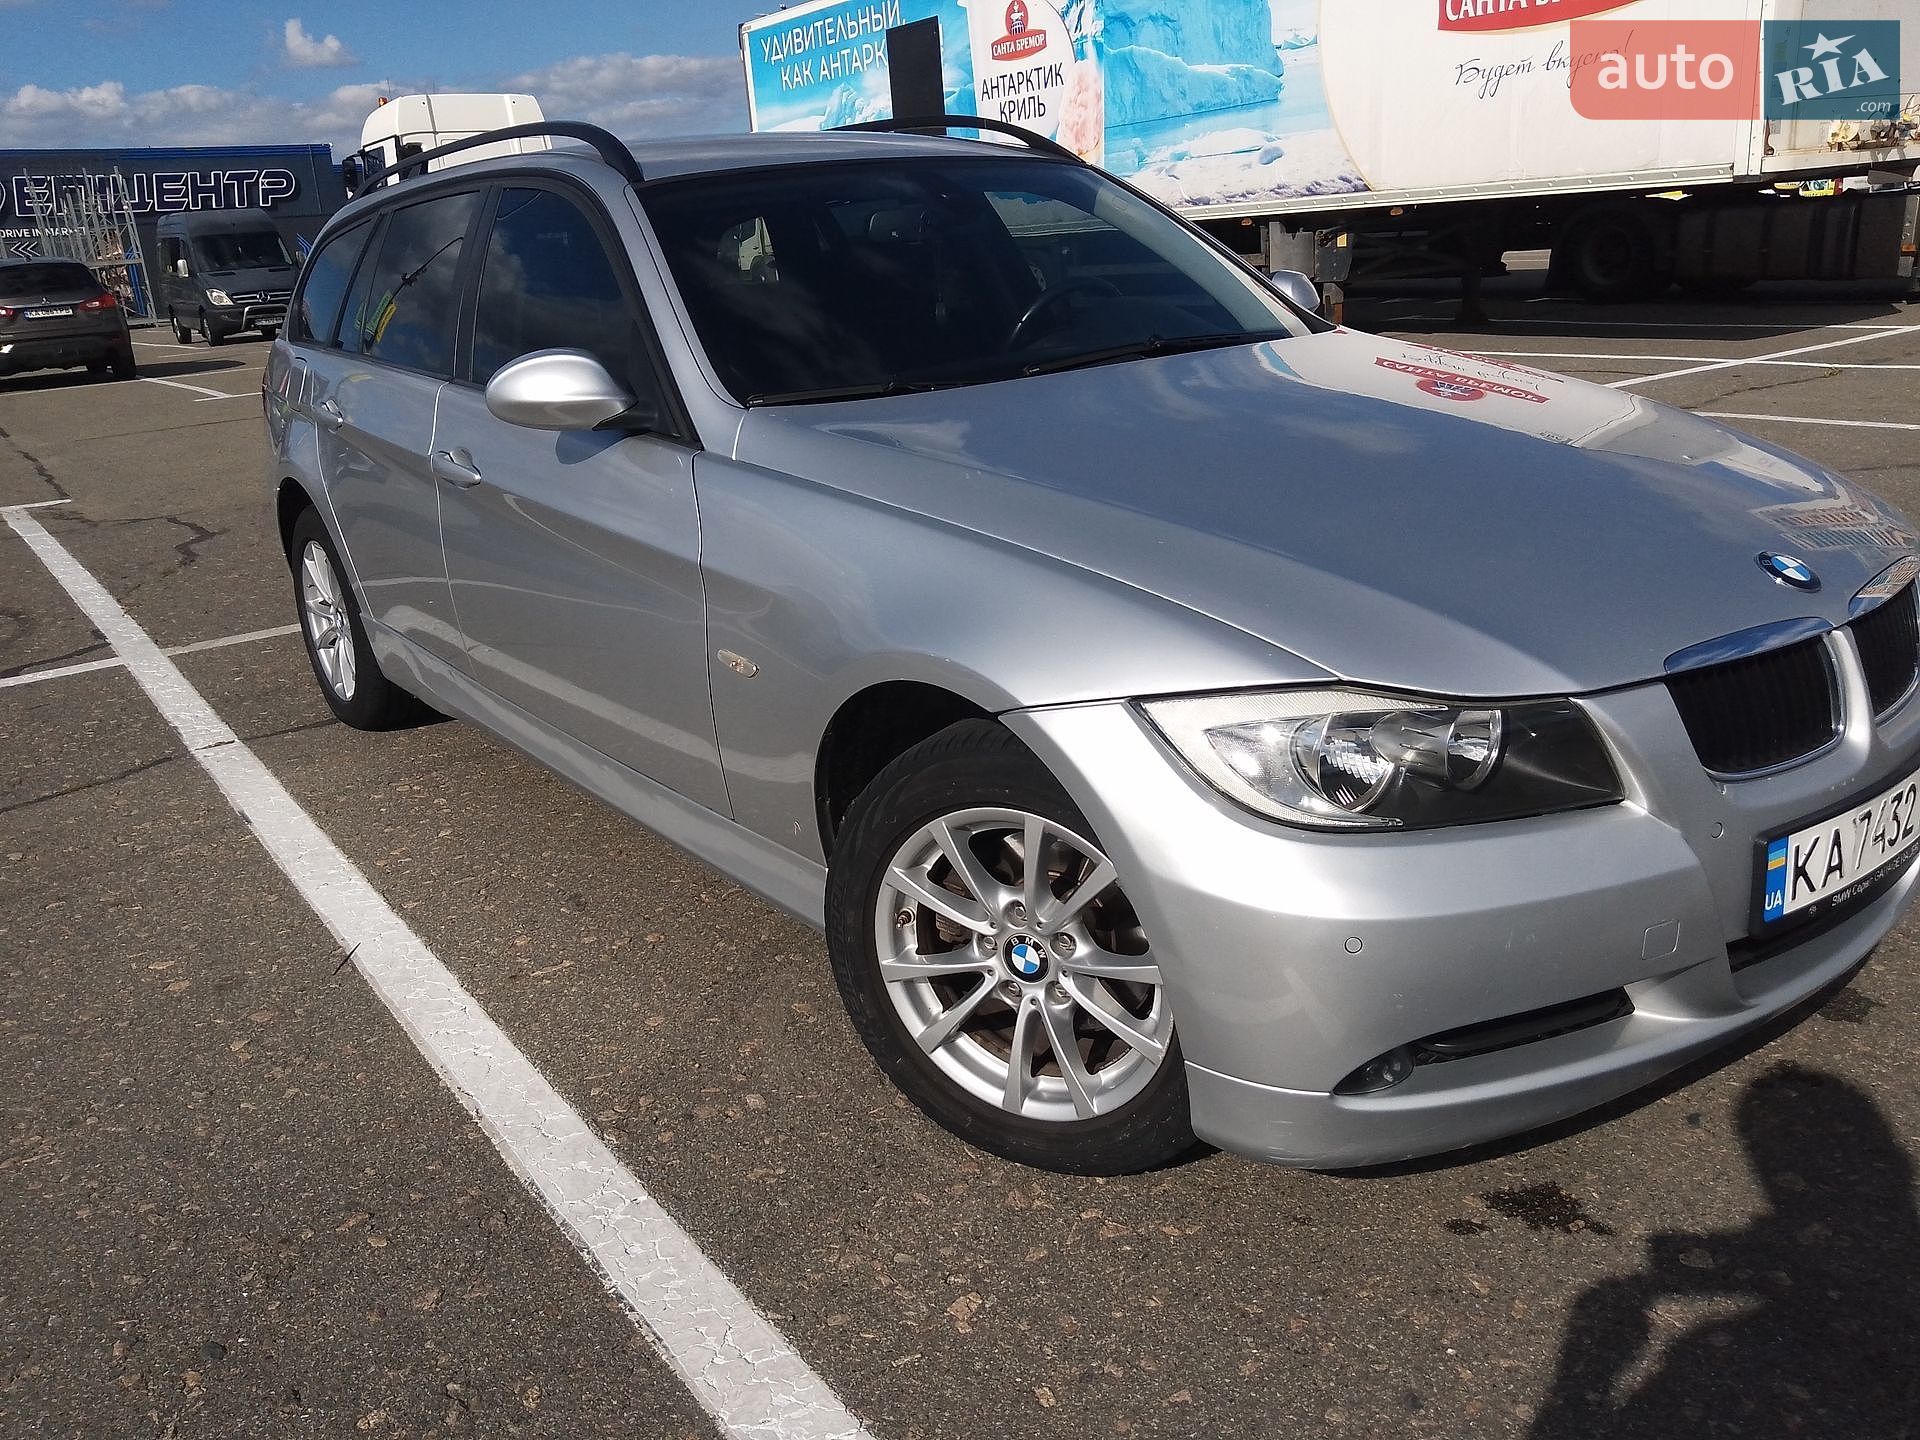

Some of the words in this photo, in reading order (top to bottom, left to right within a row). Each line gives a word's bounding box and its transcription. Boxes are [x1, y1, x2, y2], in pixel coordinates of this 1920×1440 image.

[992, 41, 1016, 57] САНТА
[1016, 34, 1045, 51] БРЕМОР
[780, 58, 815, 92] КАК
[981, 62, 1064, 102] АНТАРКТИК
[1000, 94, 1046, 123] КРИЛЬ
[0, 228, 30, 238] DRIVE
[1791, 825, 1844, 901] KA
[1852, 783, 1917, 870] 7432
[1765, 890, 1782, 911] UA
[1010, 936, 1047, 959] BMW
